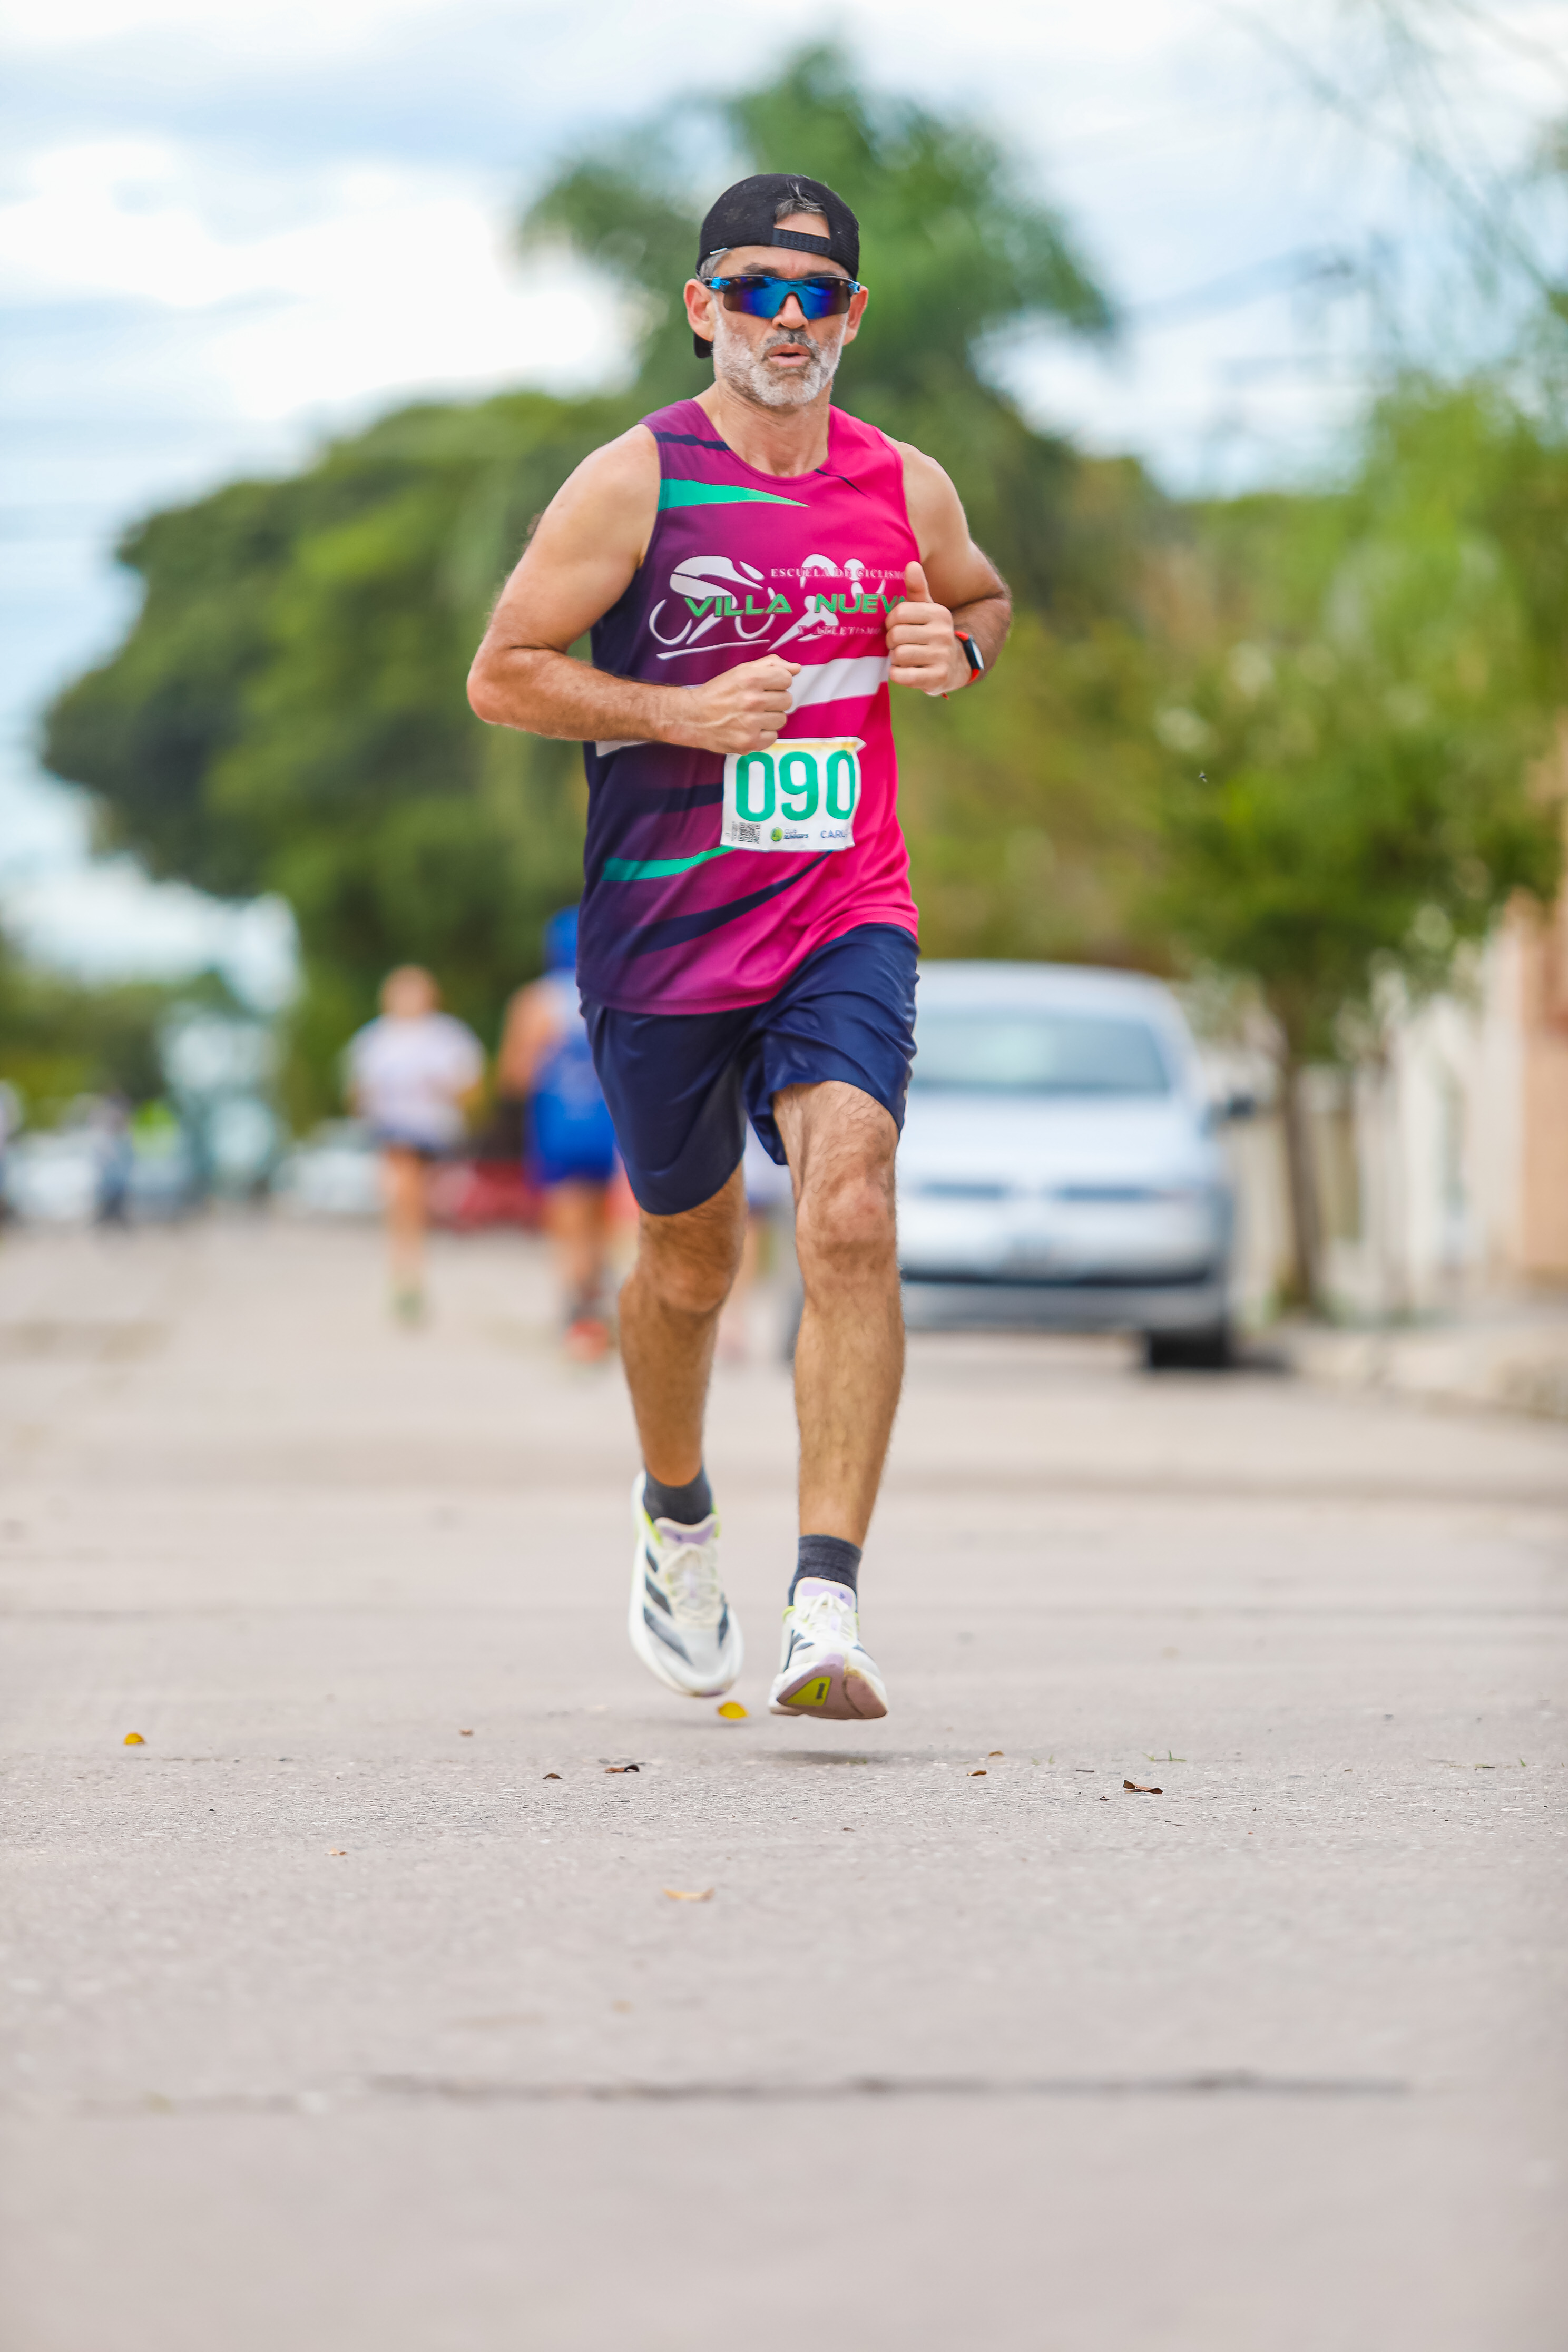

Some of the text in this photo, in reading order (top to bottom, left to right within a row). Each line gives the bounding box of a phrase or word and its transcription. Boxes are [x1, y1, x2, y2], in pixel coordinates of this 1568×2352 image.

[771, 567, 830, 577] ESCUELA
[684, 593, 792, 617] VILLA
[736, 750, 855, 822] 090
